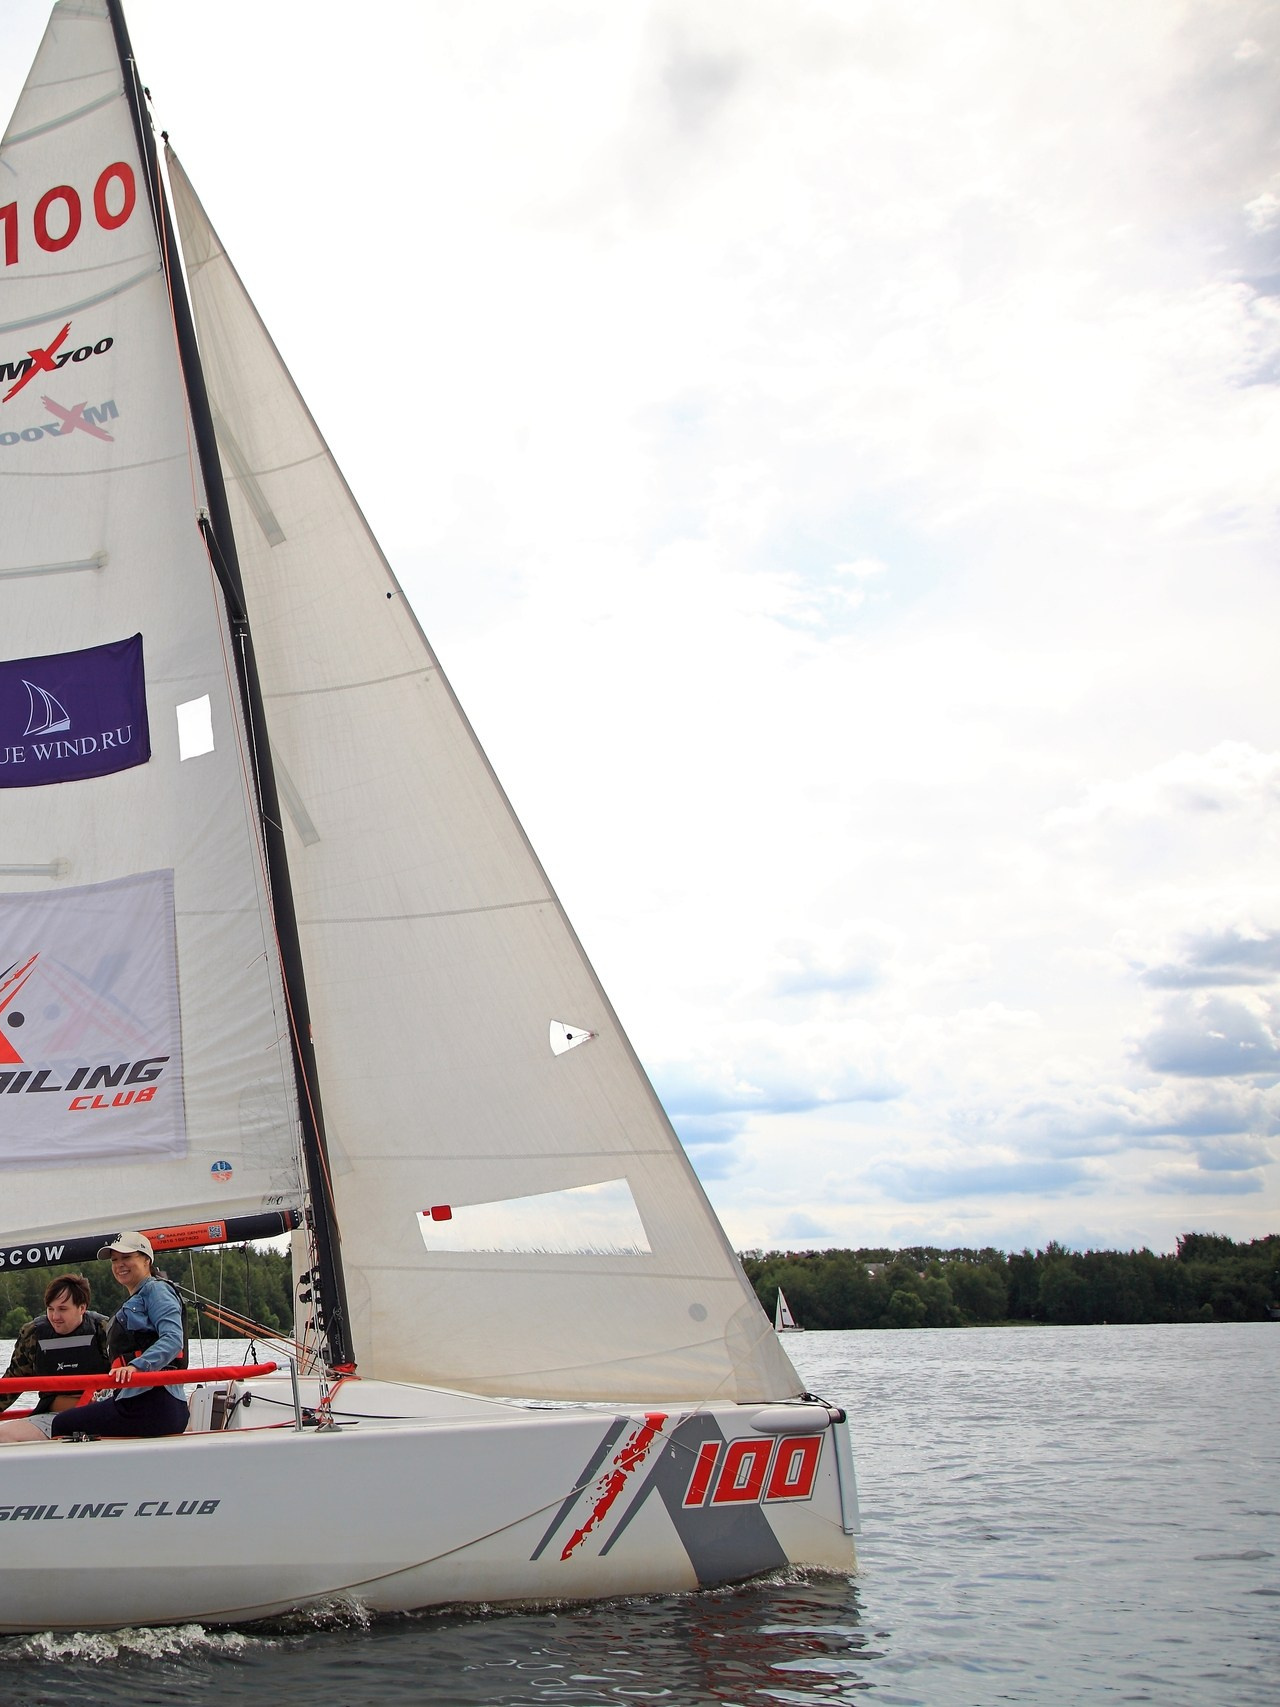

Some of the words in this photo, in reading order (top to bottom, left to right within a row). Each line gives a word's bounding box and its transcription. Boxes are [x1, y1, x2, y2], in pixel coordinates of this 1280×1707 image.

[32, 724, 133, 761] WIND.RU
[68, 1087, 158, 1111] CLUB
[682, 1432, 825, 1508] 100
[134, 1499, 221, 1517] CLUB
